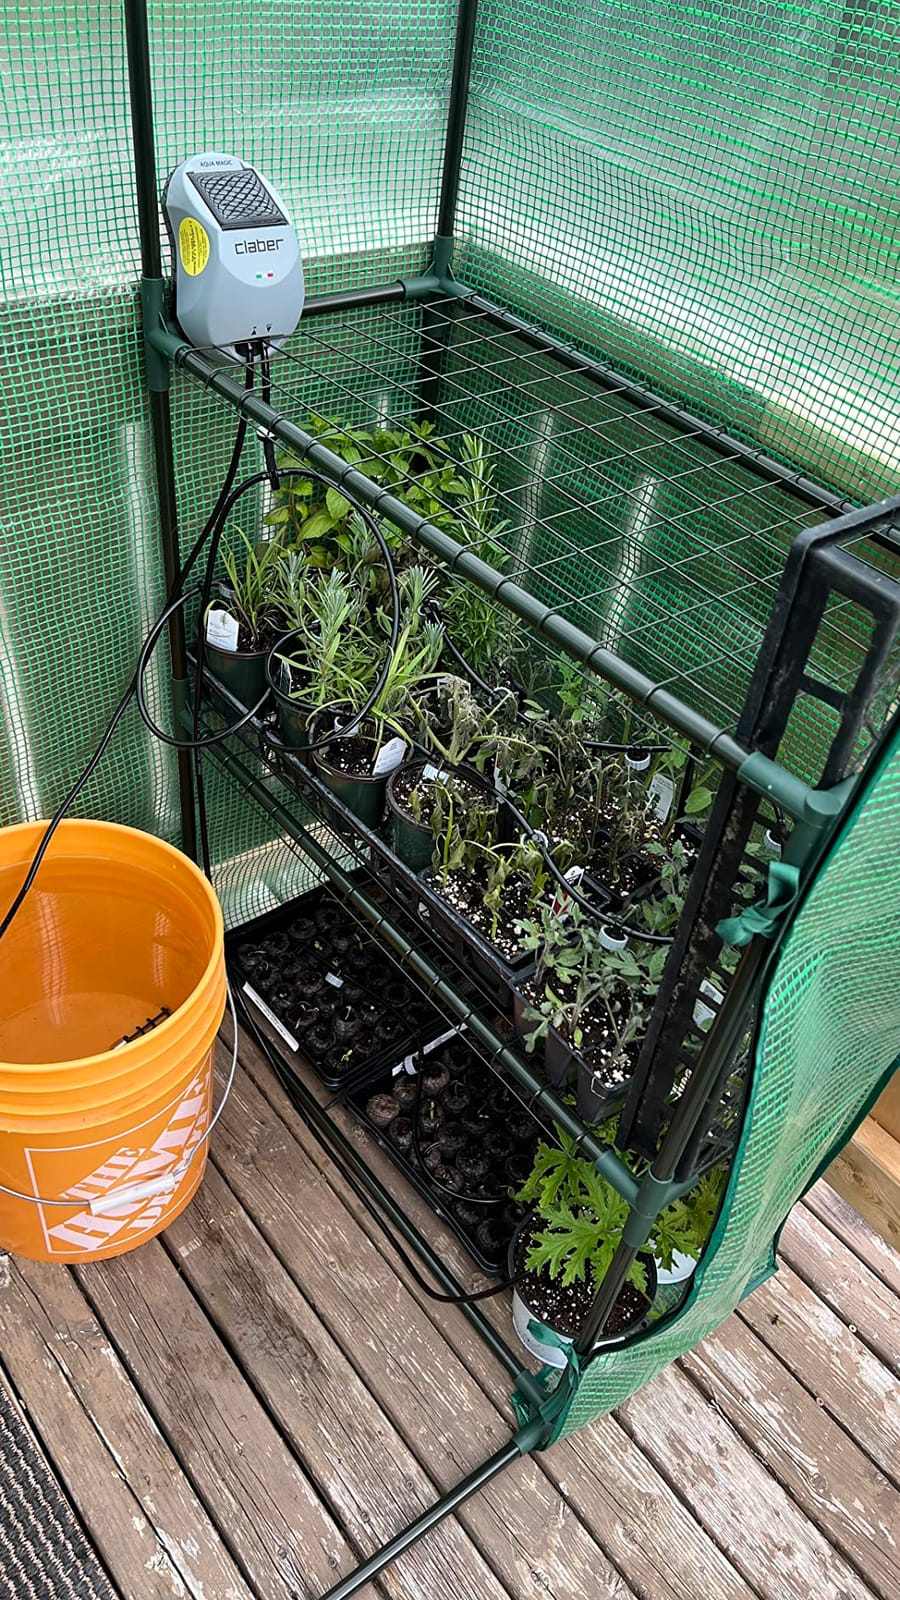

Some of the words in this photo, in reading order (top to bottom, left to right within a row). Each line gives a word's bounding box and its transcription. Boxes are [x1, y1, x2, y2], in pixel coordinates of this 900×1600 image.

[200, 160, 215, 168] AQUA
[235, 238, 284, 255] claber
[59, 1147, 147, 1200] THE
